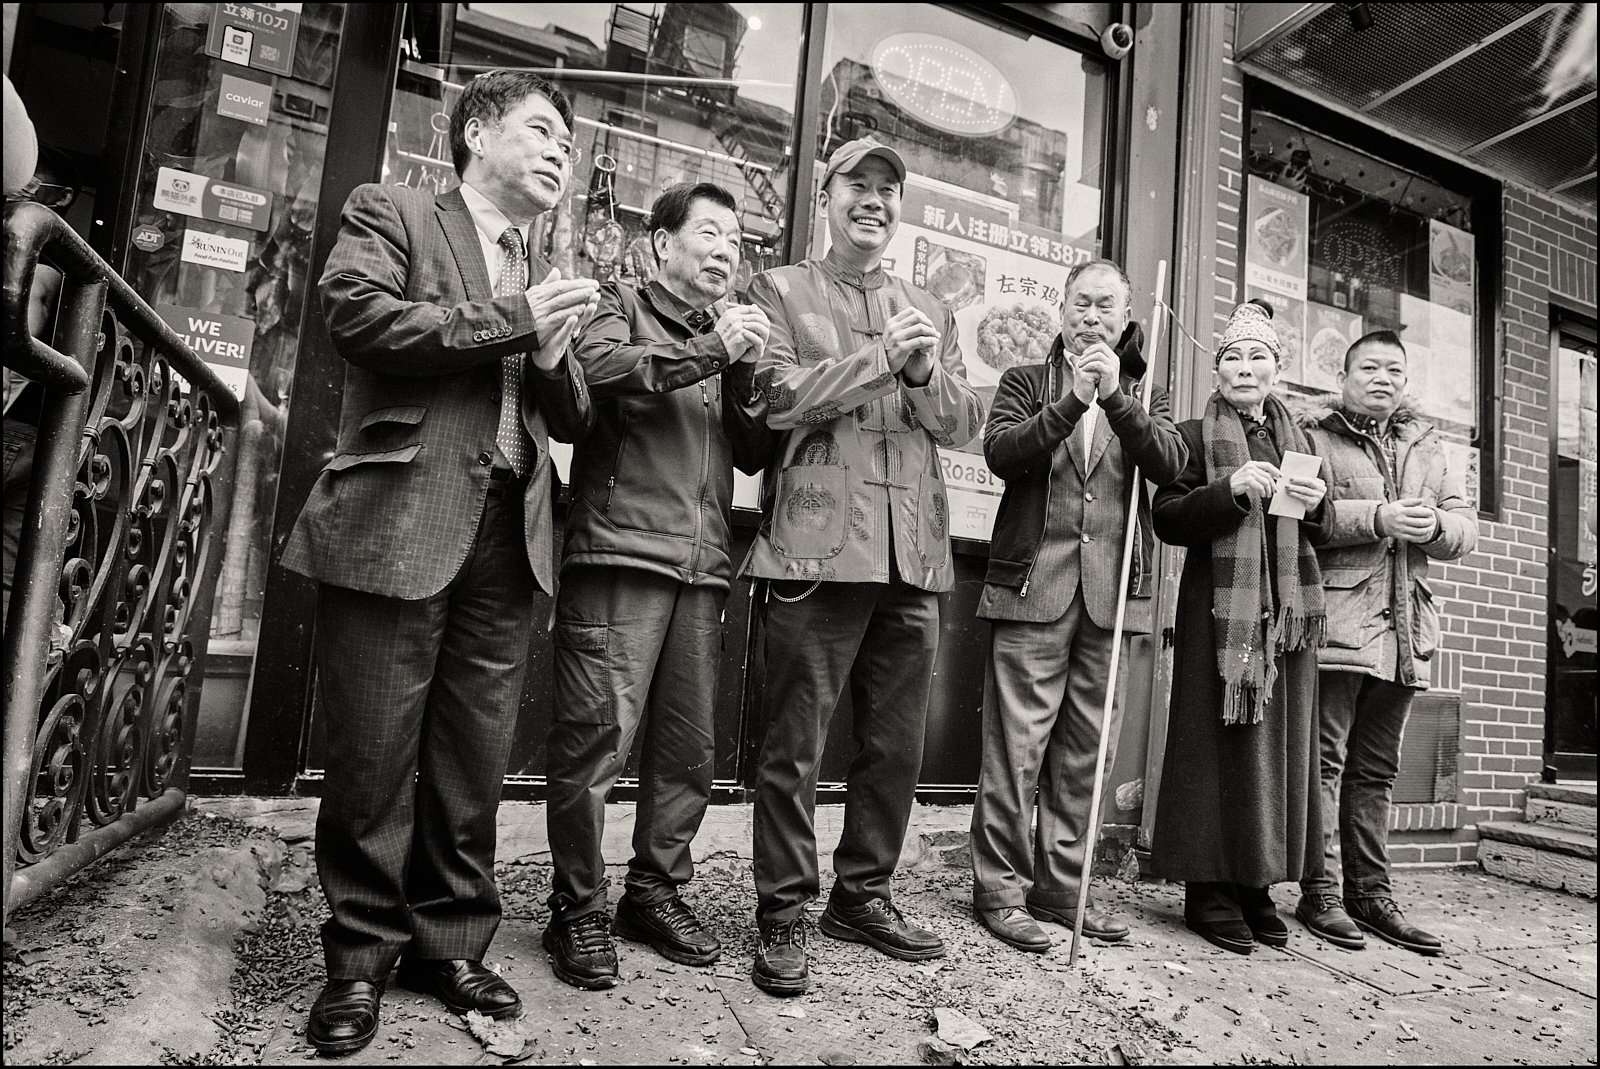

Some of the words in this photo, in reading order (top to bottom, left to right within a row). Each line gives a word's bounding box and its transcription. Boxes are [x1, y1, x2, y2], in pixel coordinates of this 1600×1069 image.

[878, 46, 1003, 124] OPEN
[226, 93, 264, 108] caviar
[161, 189, 197, 203] 熊猫外卖
[136, 231, 161, 243] ADT
[923, 204, 1092, 265] 新人注册立领38刀
[915, 240, 928, 287] 北京烤鸭
[1323, 233, 1402, 284] OPEN
[996, 273, 1059, 306] 左宗鸡
[188, 317, 222, 337] WE
[175, 333, 246, 359] LIVER!
[940, 456, 994, 486] Roast
